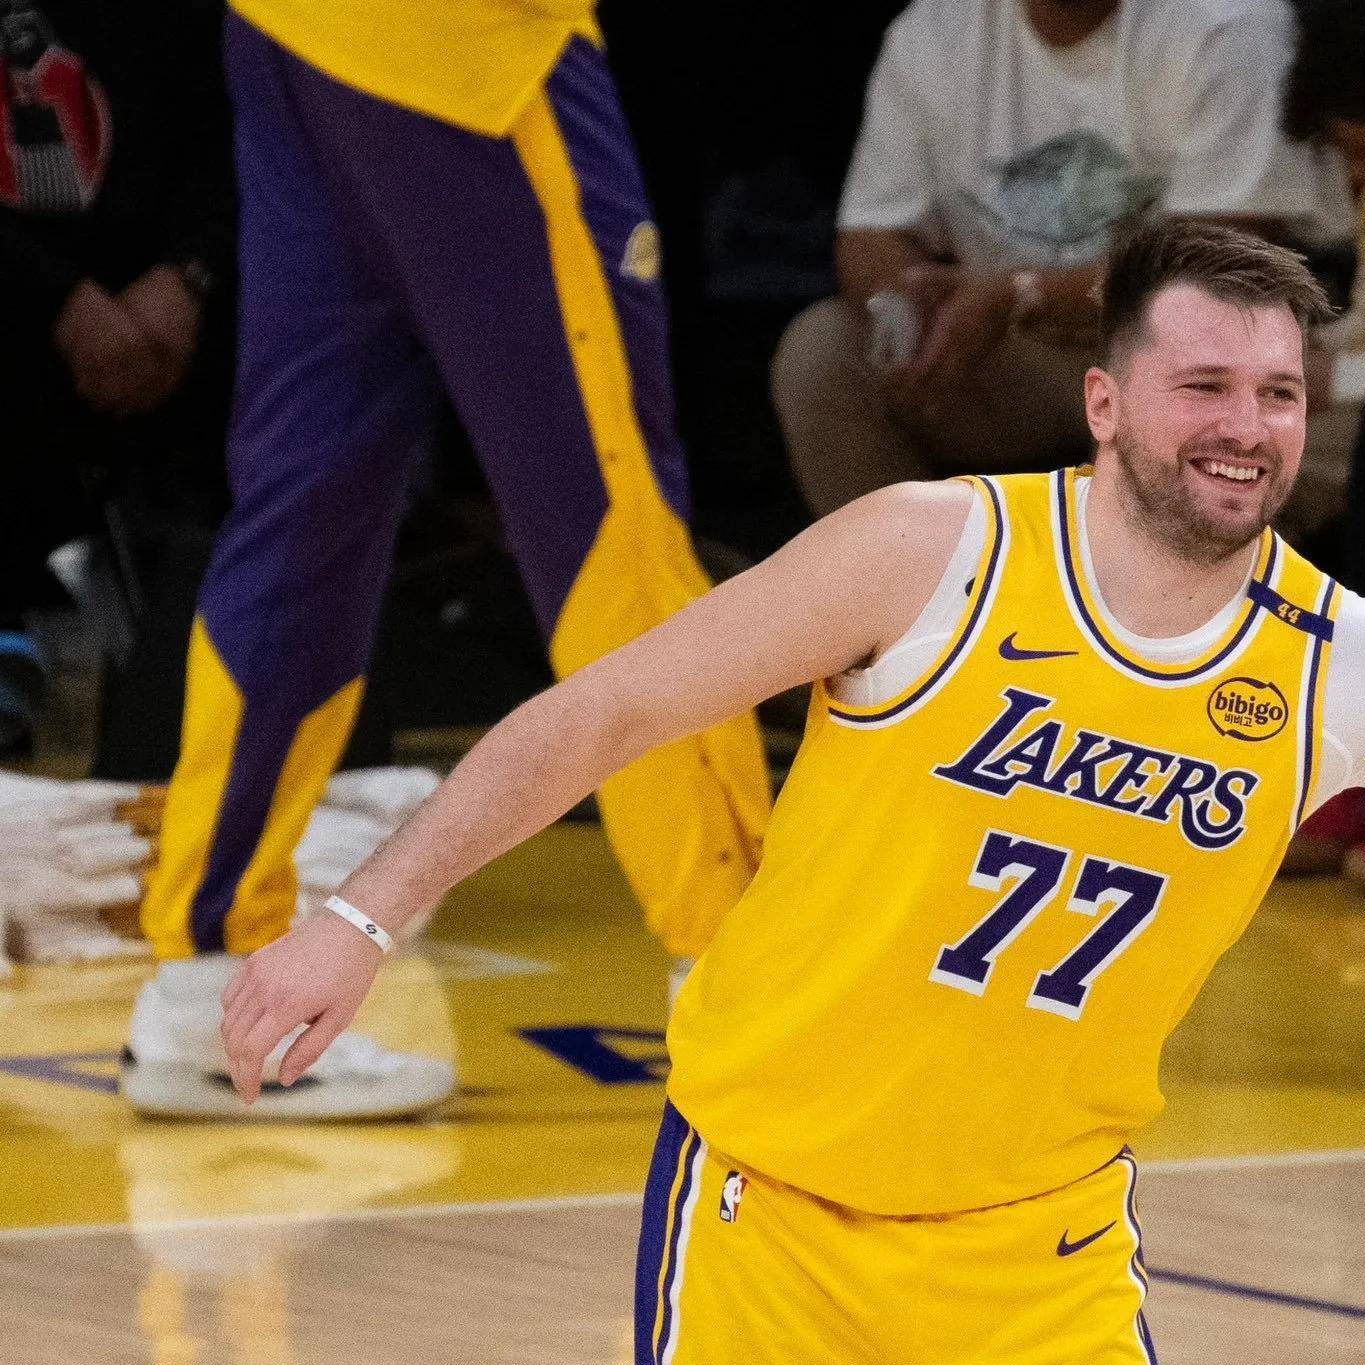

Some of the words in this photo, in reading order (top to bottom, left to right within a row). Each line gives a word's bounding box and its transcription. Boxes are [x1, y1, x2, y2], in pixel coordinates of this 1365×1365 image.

[1277, 602, 1300, 624] 44
[1214, 690, 1284, 726] bibigo
[1223, 712, 1253, 728] 비비고
[932, 687, 1261, 851] LAKERS
[928, 827, 1170, 1022] 77
